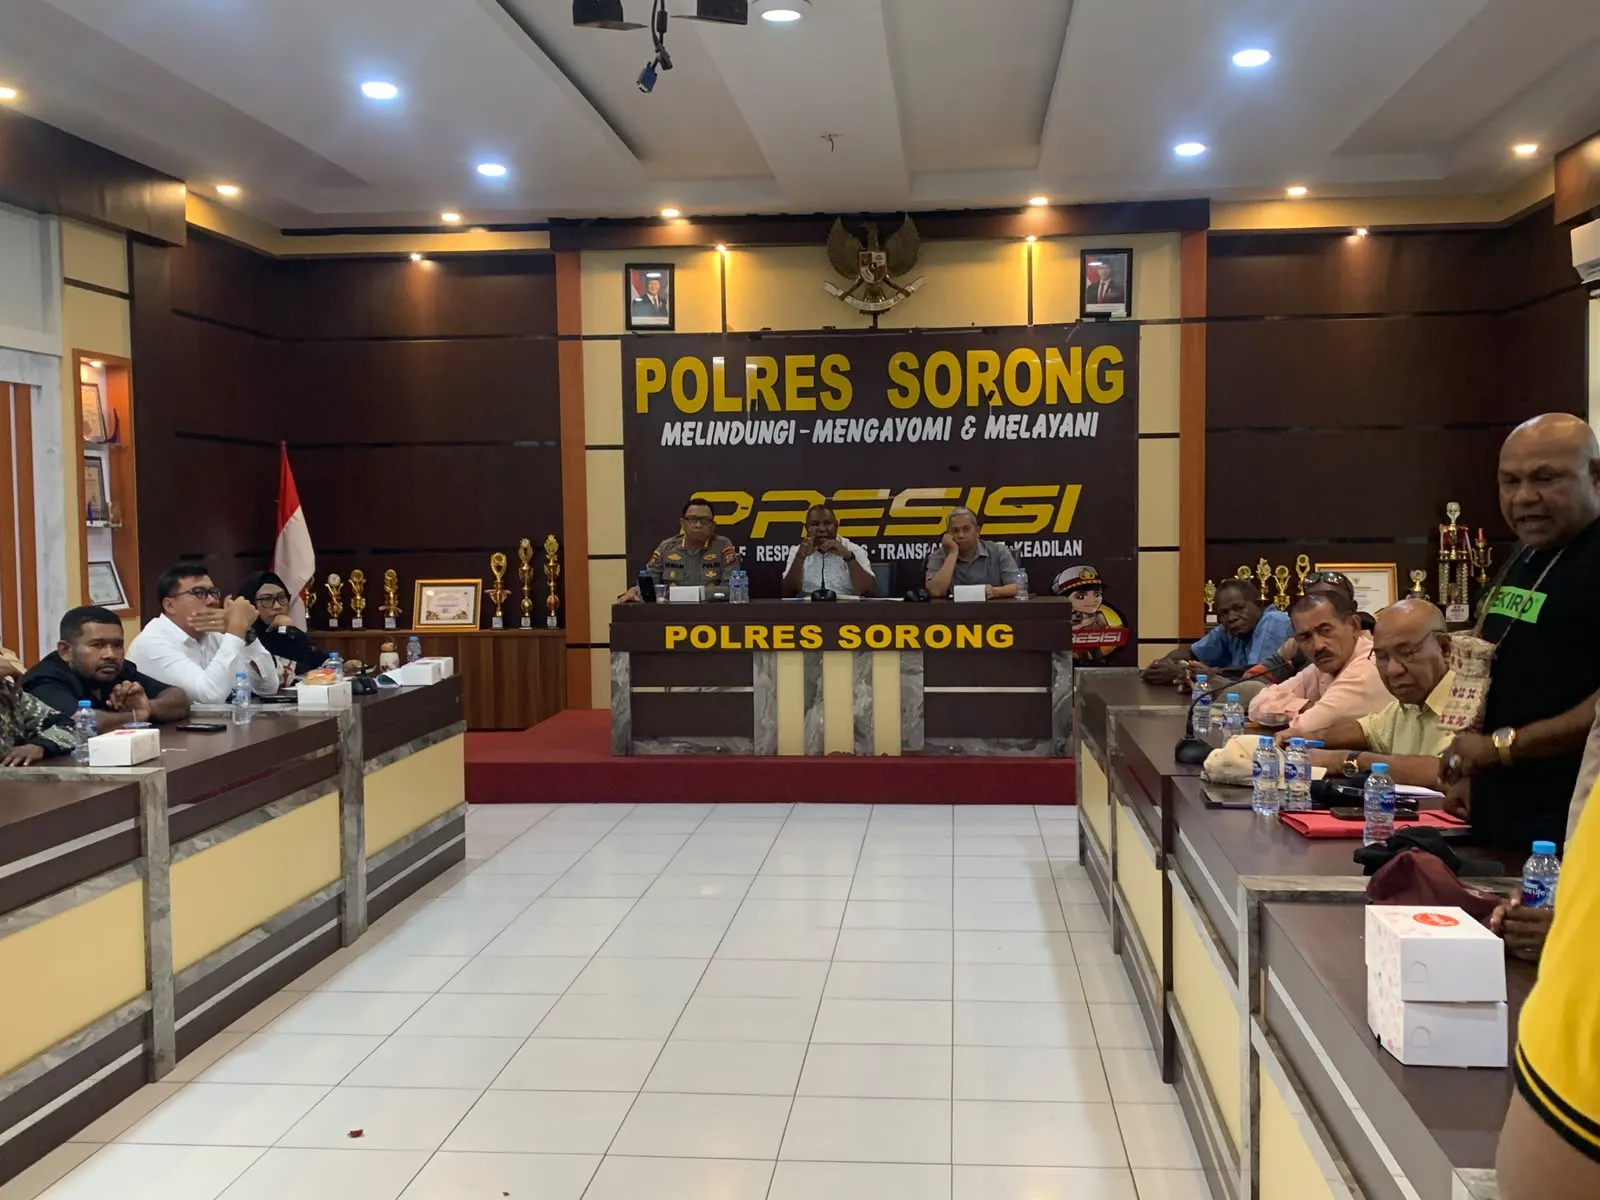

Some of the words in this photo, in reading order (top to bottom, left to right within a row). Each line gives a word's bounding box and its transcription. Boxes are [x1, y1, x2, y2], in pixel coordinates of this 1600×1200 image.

[636, 353, 853, 413] POLRES
[887, 345, 1124, 409] SORONG
[661, 419, 796, 446] MELINDUNGI
[812, 415, 952, 443] MENGAYOMI
[961, 415, 976, 440] &
[984, 412, 1099, 440] MELAYANI
[680, 484, 1083, 538] PRESISI
[665, 624, 823, 649] POLRES
[838, 623, 1014, 649] SORONG
